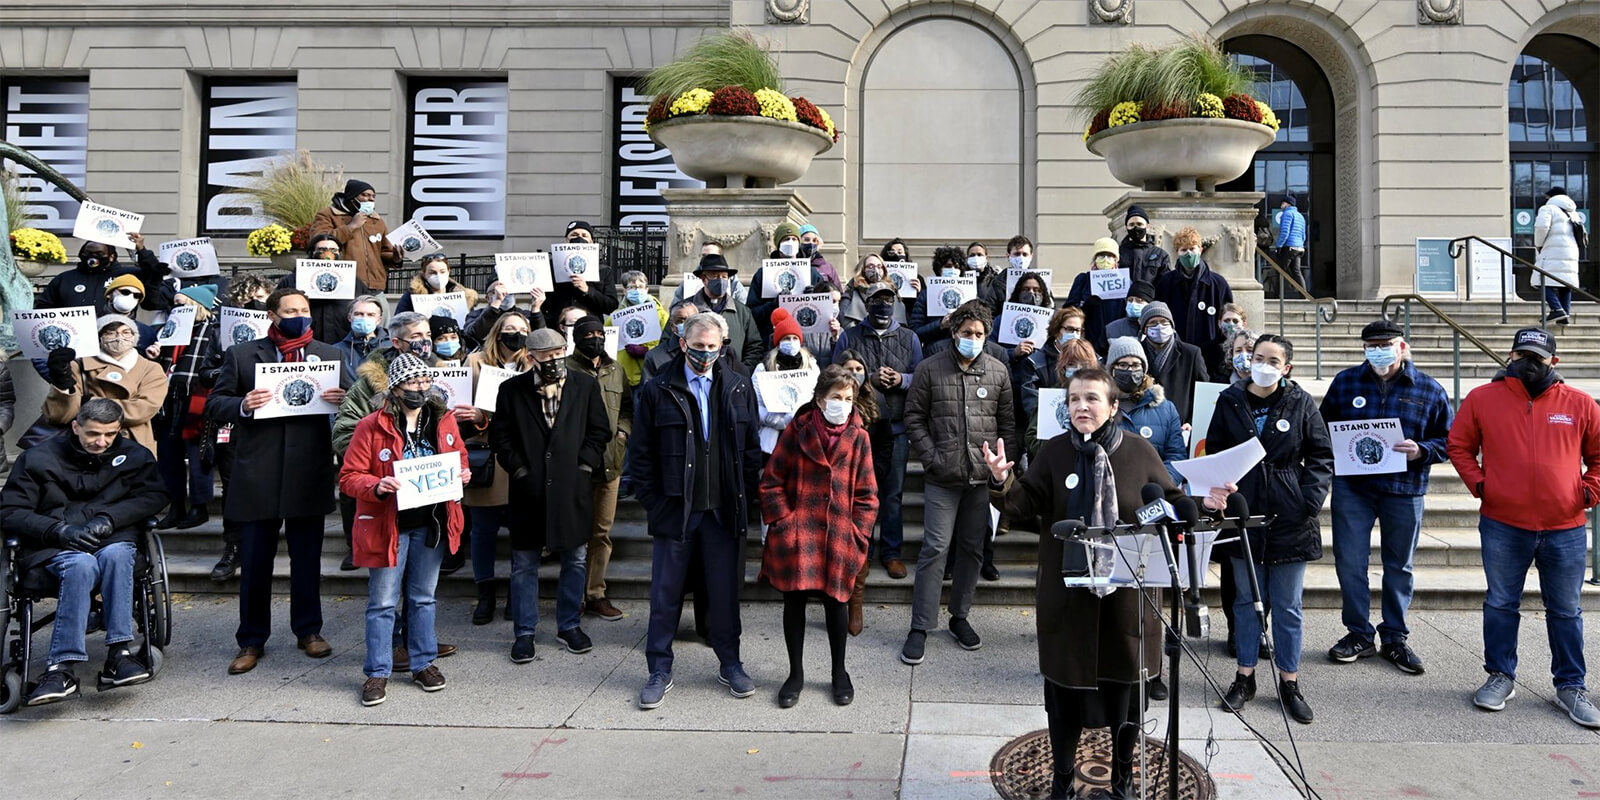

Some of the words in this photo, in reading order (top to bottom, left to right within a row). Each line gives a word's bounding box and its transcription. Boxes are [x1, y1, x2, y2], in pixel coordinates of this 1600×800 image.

[206, 86, 297, 229] PAIN
[411, 88, 508, 230] POWER
[91, 205, 117, 216] STAND
[120, 212, 140, 220] WITH
[415, 224, 428, 240] STAND
[428, 239, 439, 250] WITH
[1097, 278, 1126, 292] YES!
[60, 309, 89, 318] WITH
[616, 309, 636, 318] STAND
[636, 304, 653, 312] WITH
[270, 365, 305, 374] STAND
[1340, 423, 1370, 432] STAND
[414, 461, 442, 471] VOTING
[408, 466, 454, 493] YES!
[1138, 502, 1163, 520] WGN
